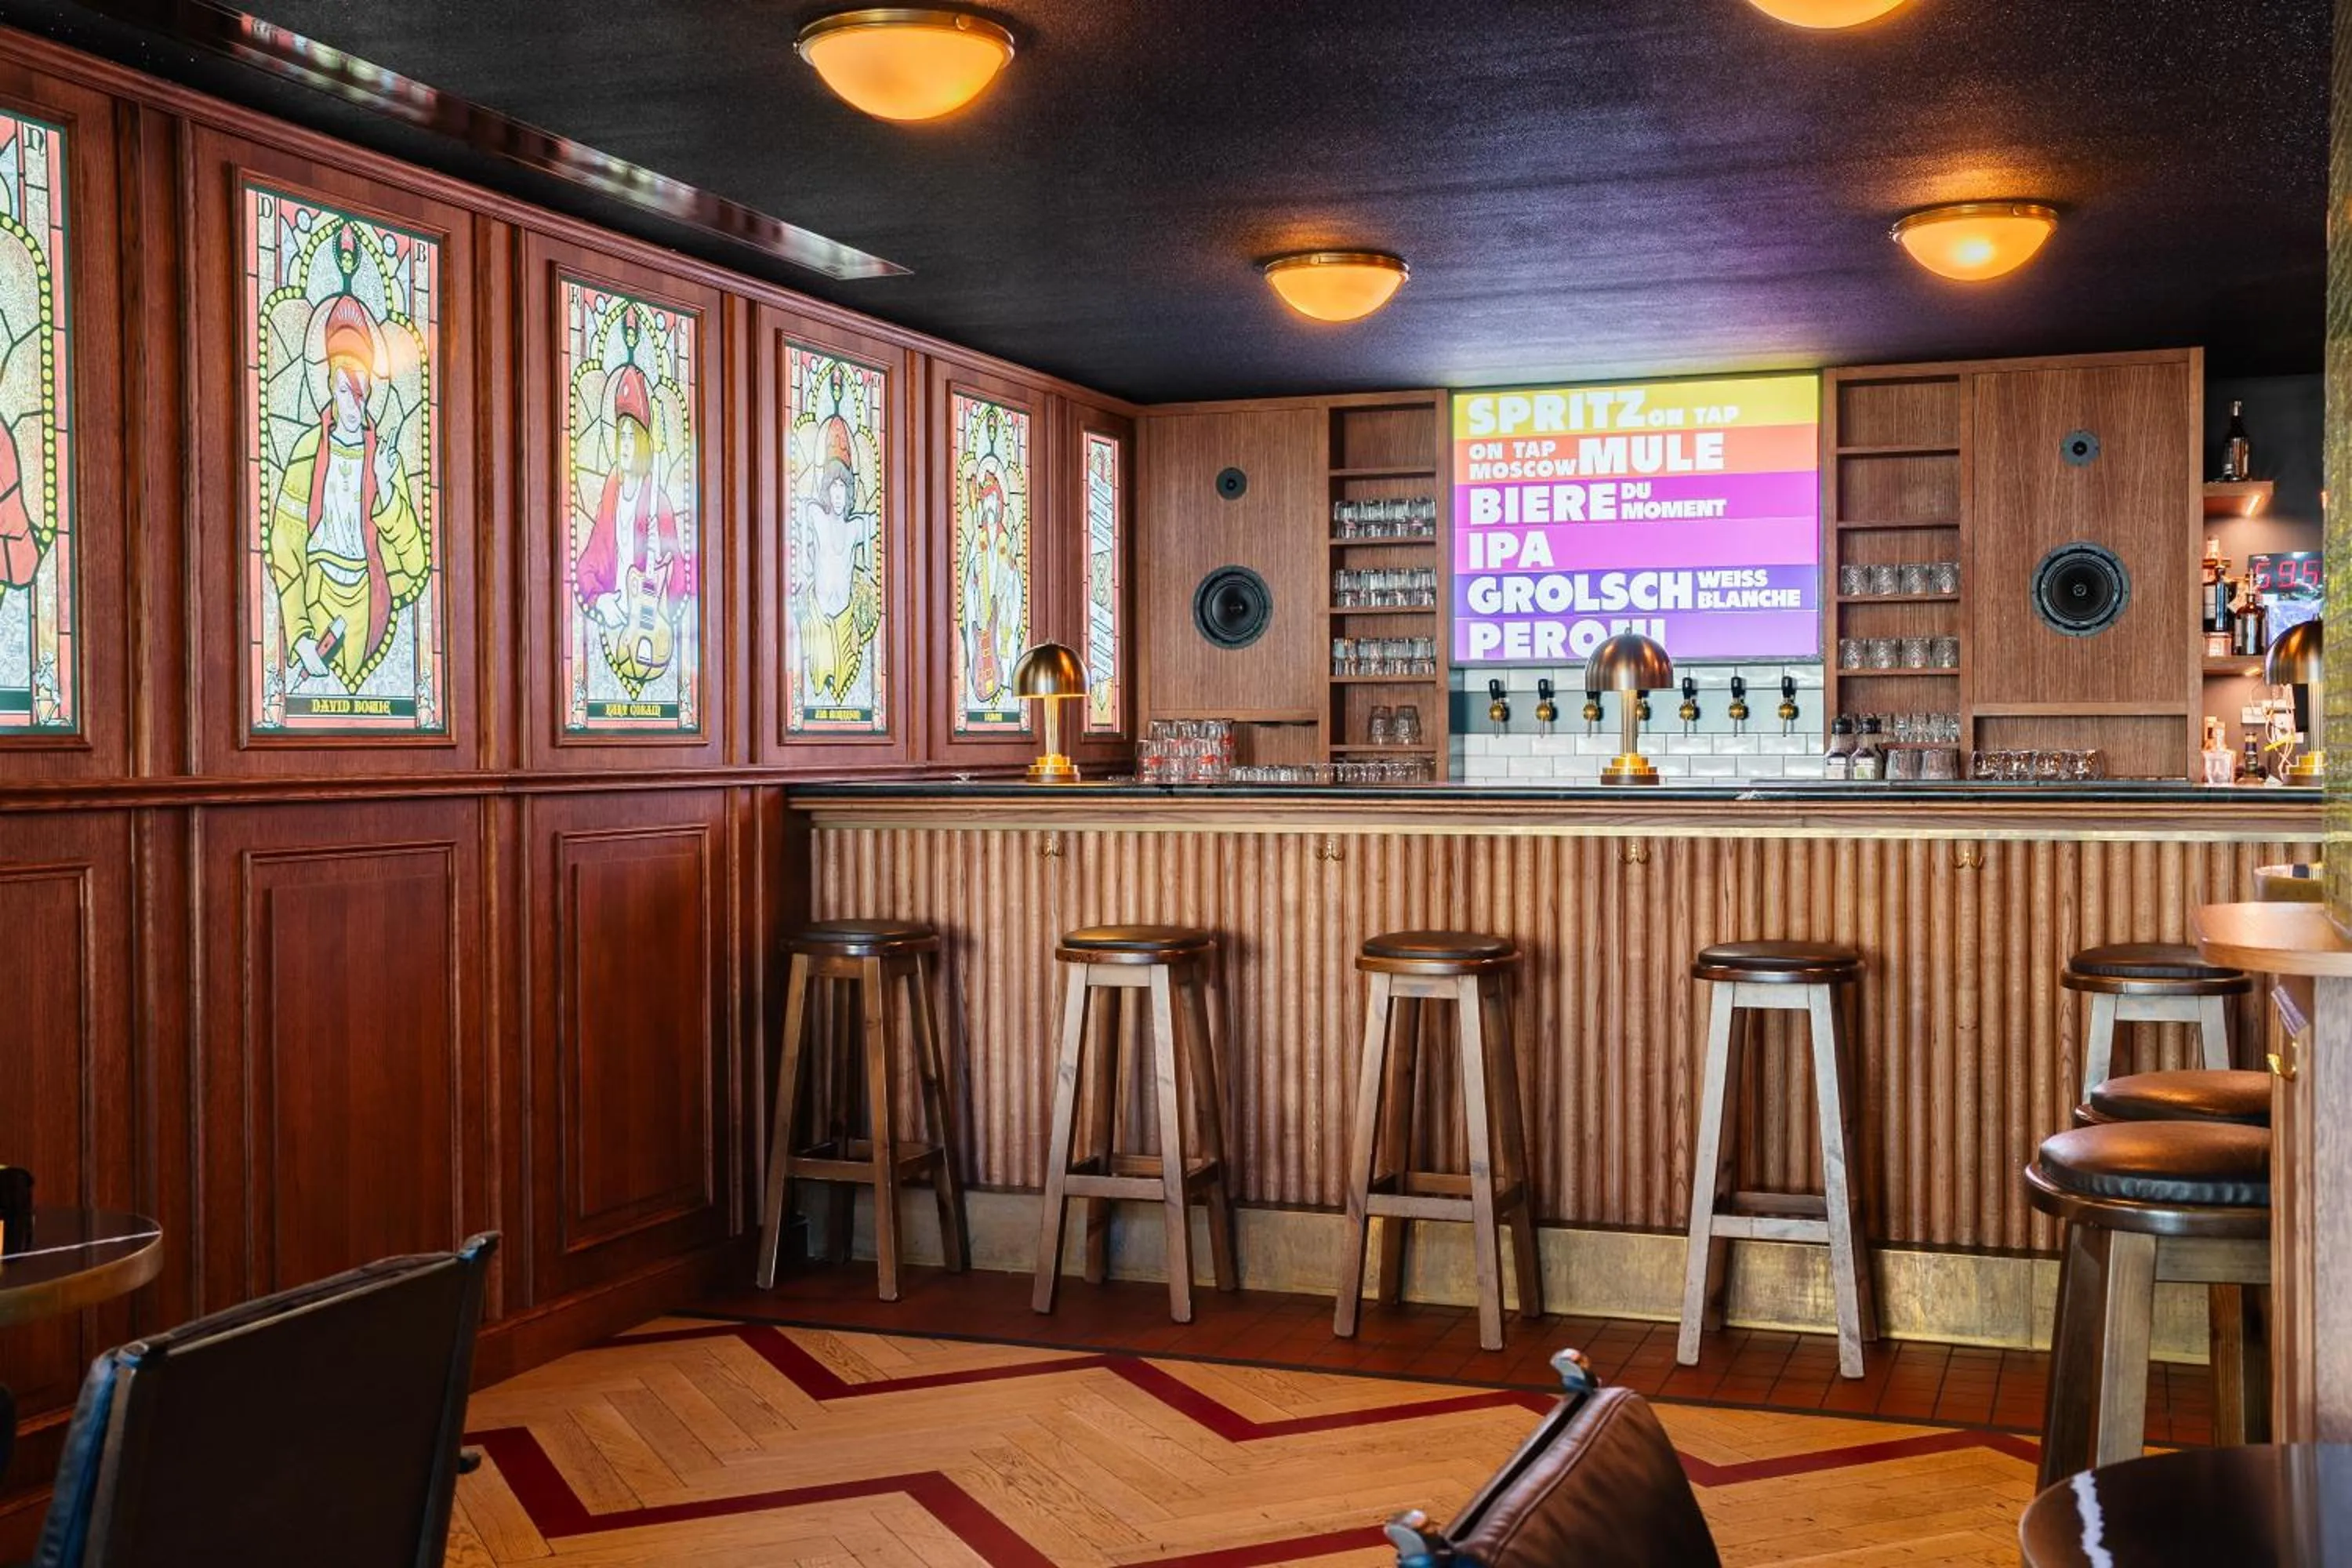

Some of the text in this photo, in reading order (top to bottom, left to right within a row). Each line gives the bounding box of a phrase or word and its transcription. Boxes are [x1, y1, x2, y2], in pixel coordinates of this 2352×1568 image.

[1467, 390, 1740, 434] SPRITZ ON TAP
[1468, 441, 1556, 460] ON TAP
[1468, 433, 1724, 480] MOSCOW MULE
[1470, 482, 1651, 524] BIERE DU
[1621, 499, 1726, 520] MOMENT
[1468, 531, 1555, 569] IPA
[1467, 569, 1768, 615] GROLSCH WEISS
[1697, 590, 1801, 609] BLANCHE
[312, 699, 350, 713] DAVID
